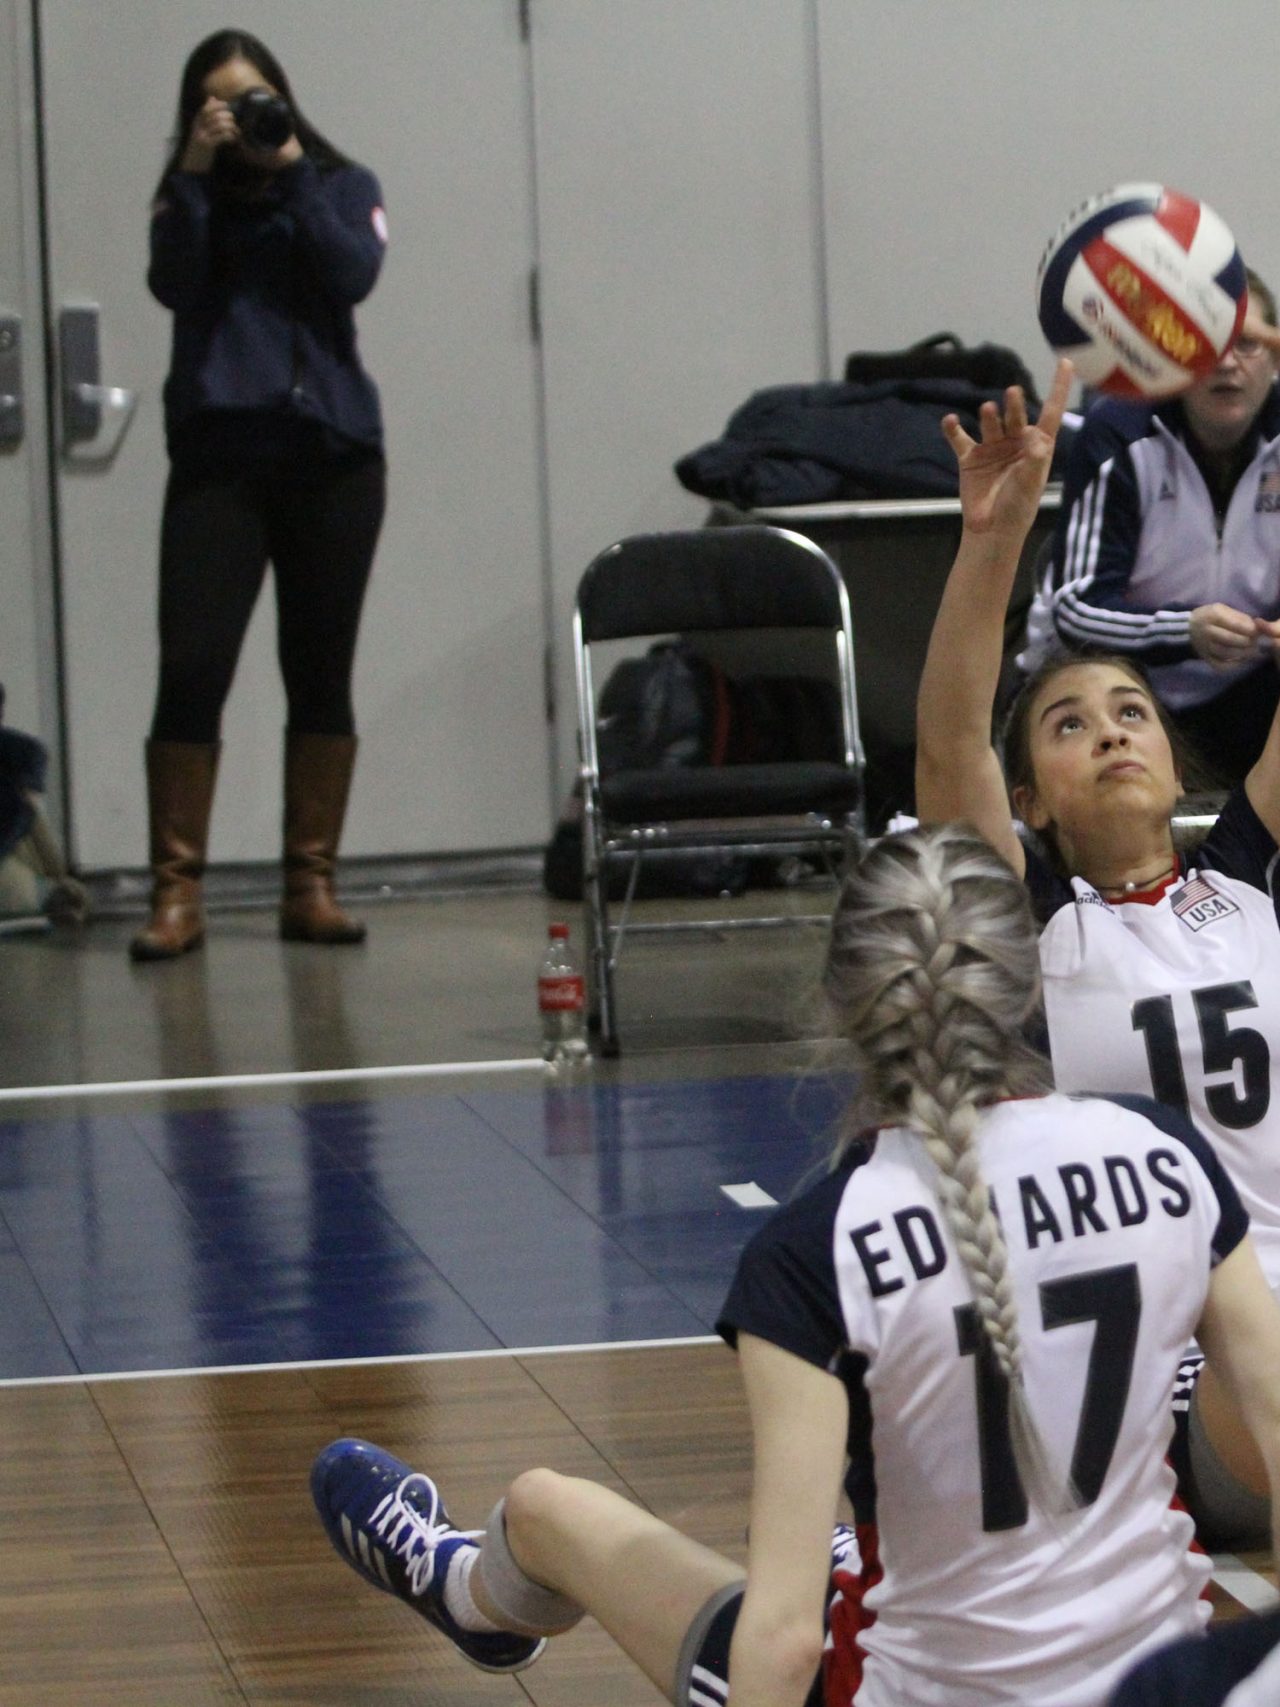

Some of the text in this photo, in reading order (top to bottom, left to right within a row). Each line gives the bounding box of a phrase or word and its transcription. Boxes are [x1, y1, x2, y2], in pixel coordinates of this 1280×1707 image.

[1189, 899, 1229, 922] USA
[1131, 980, 1270, 1130] 15
[849, 1148, 1191, 1298] EDARDS
[953, 1262, 1142, 1532] 17
